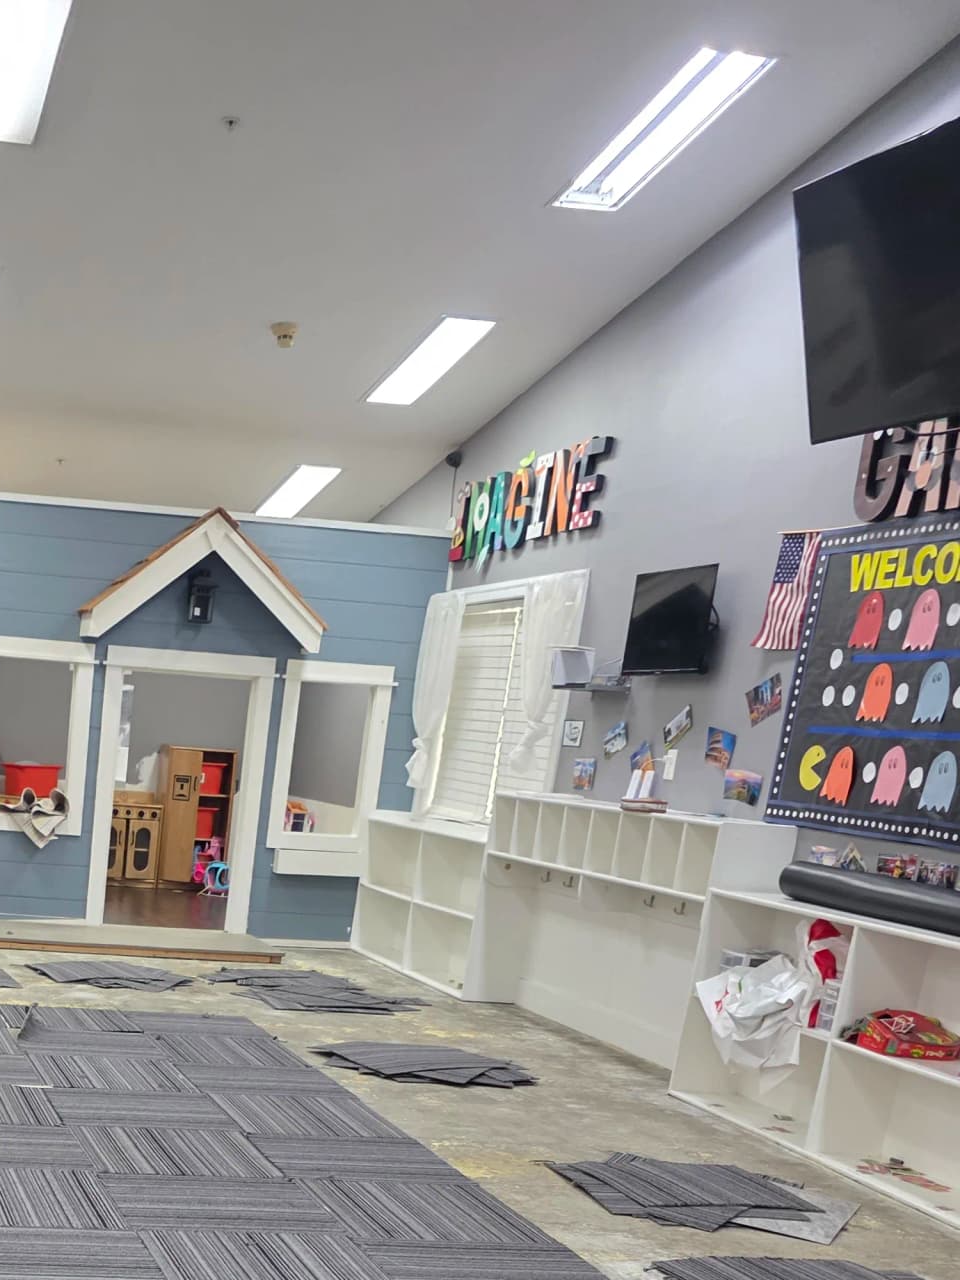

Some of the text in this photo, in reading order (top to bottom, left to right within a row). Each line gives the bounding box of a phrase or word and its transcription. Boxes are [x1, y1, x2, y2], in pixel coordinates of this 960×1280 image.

[448, 436, 615, 562] IMAGINE
[853, 418, 960, 522] GA
[850, 541, 960, 592] WELCO
